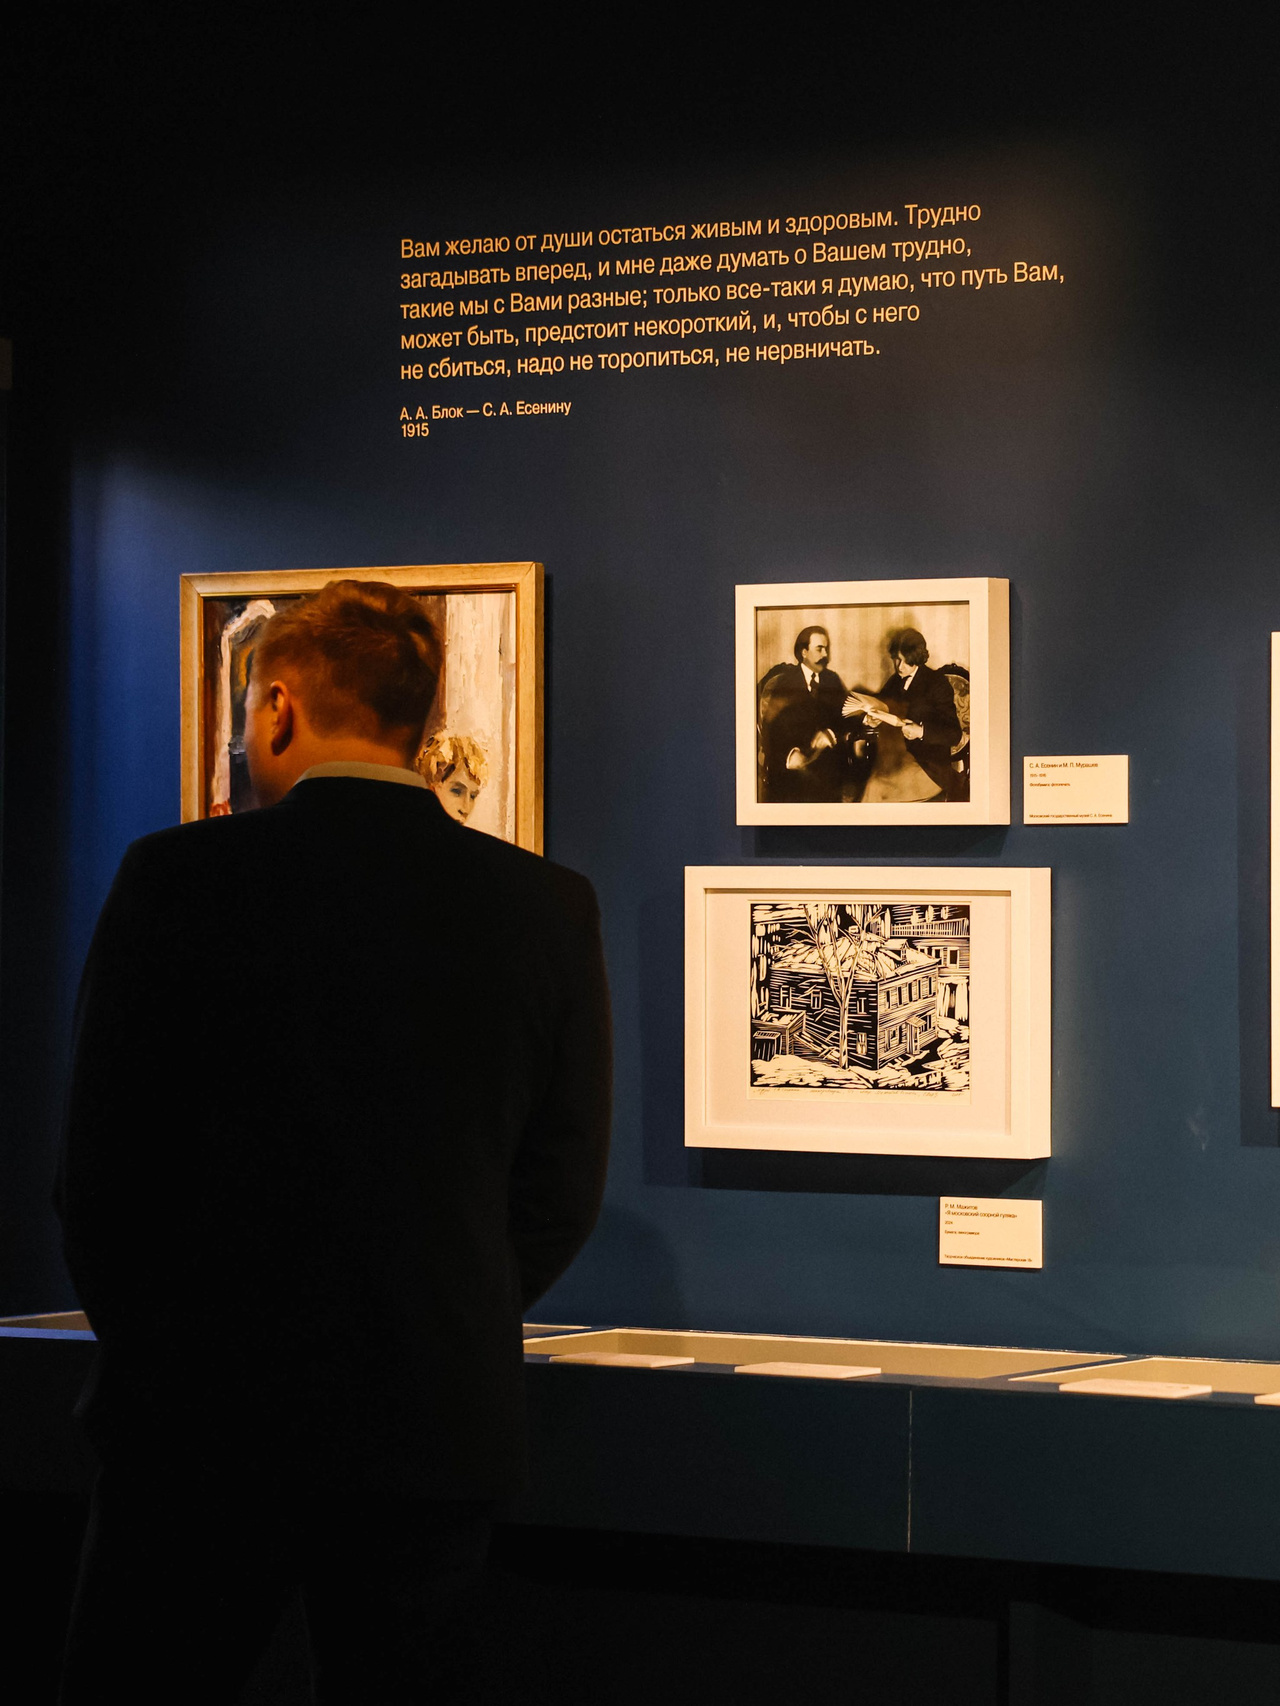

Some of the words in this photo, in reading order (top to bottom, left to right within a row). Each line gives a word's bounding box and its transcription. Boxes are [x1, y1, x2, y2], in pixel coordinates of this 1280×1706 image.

[904, 204, 981, 229] Трудно
[401, 239, 440, 258] Вам
[445, 237, 510, 255] желаю
[515, 235, 537, 251] от
[541, 231, 592, 253] души
[599, 225, 685, 245] остаться
[691, 220, 761, 239] живым
[768, 219, 779, 234] и
[786, 211, 898, 235] здоровым.
[795, 248, 806, 264] о
[813, 242, 886, 263] Вашем
[892, 238, 971, 262] трудно,
[599, 261, 609, 276] и
[616, 258, 655, 275] мне
[659, 254, 712, 276] даже
[717, 250, 789, 273] думать
[401, 268, 510, 289] загадывать
[516, 263, 591, 284] вперед,
[921, 271, 955, 287] что
[962, 268, 1008, 289] путь
[1014, 262, 1064, 283] Вам,
[653, 285, 720, 304] только
[727, 280, 815, 299] все-таки
[822, 279, 832, 294] я
[838, 274, 914, 297] думаю,
[400, 301, 454, 319] такие
[460, 299, 488, 315] мы
[494, 298, 505, 313] с
[511, 293, 562, 312] Вами
[568, 290, 647, 314] разные;
[764, 314, 781, 332] и,
[788, 304, 849, 327] чтобы
[856, 308, 867, 324] с
[873, 305, 920, 322] него
[634, 310, 756, 338] некороткий,
[401, 331, 463, 349] может
[467, 325, 519, 346] быть,
[526, 322, 629, 346] предстоит
[598, 349, 719, 373] торопиться,
[726, 346, 750, 362] не
[756, 340, 880, 364] нервничать.
[401, 364, 423, 379] не
[428, 357, 511, 378] сбиться,
[518, 356, 564, 375] надо
[570, 355, 593, 370] не
[400, 407, 412, 421] А.
[415, 406, 428, 420] А.
[432, 405, 464, 419] Блок
[483, 402, 496, 416] С.
[500, 402, 512, 416] А.
[516, 401, 571, 416] Есенину
[402, 422, 429, 437] 1915
